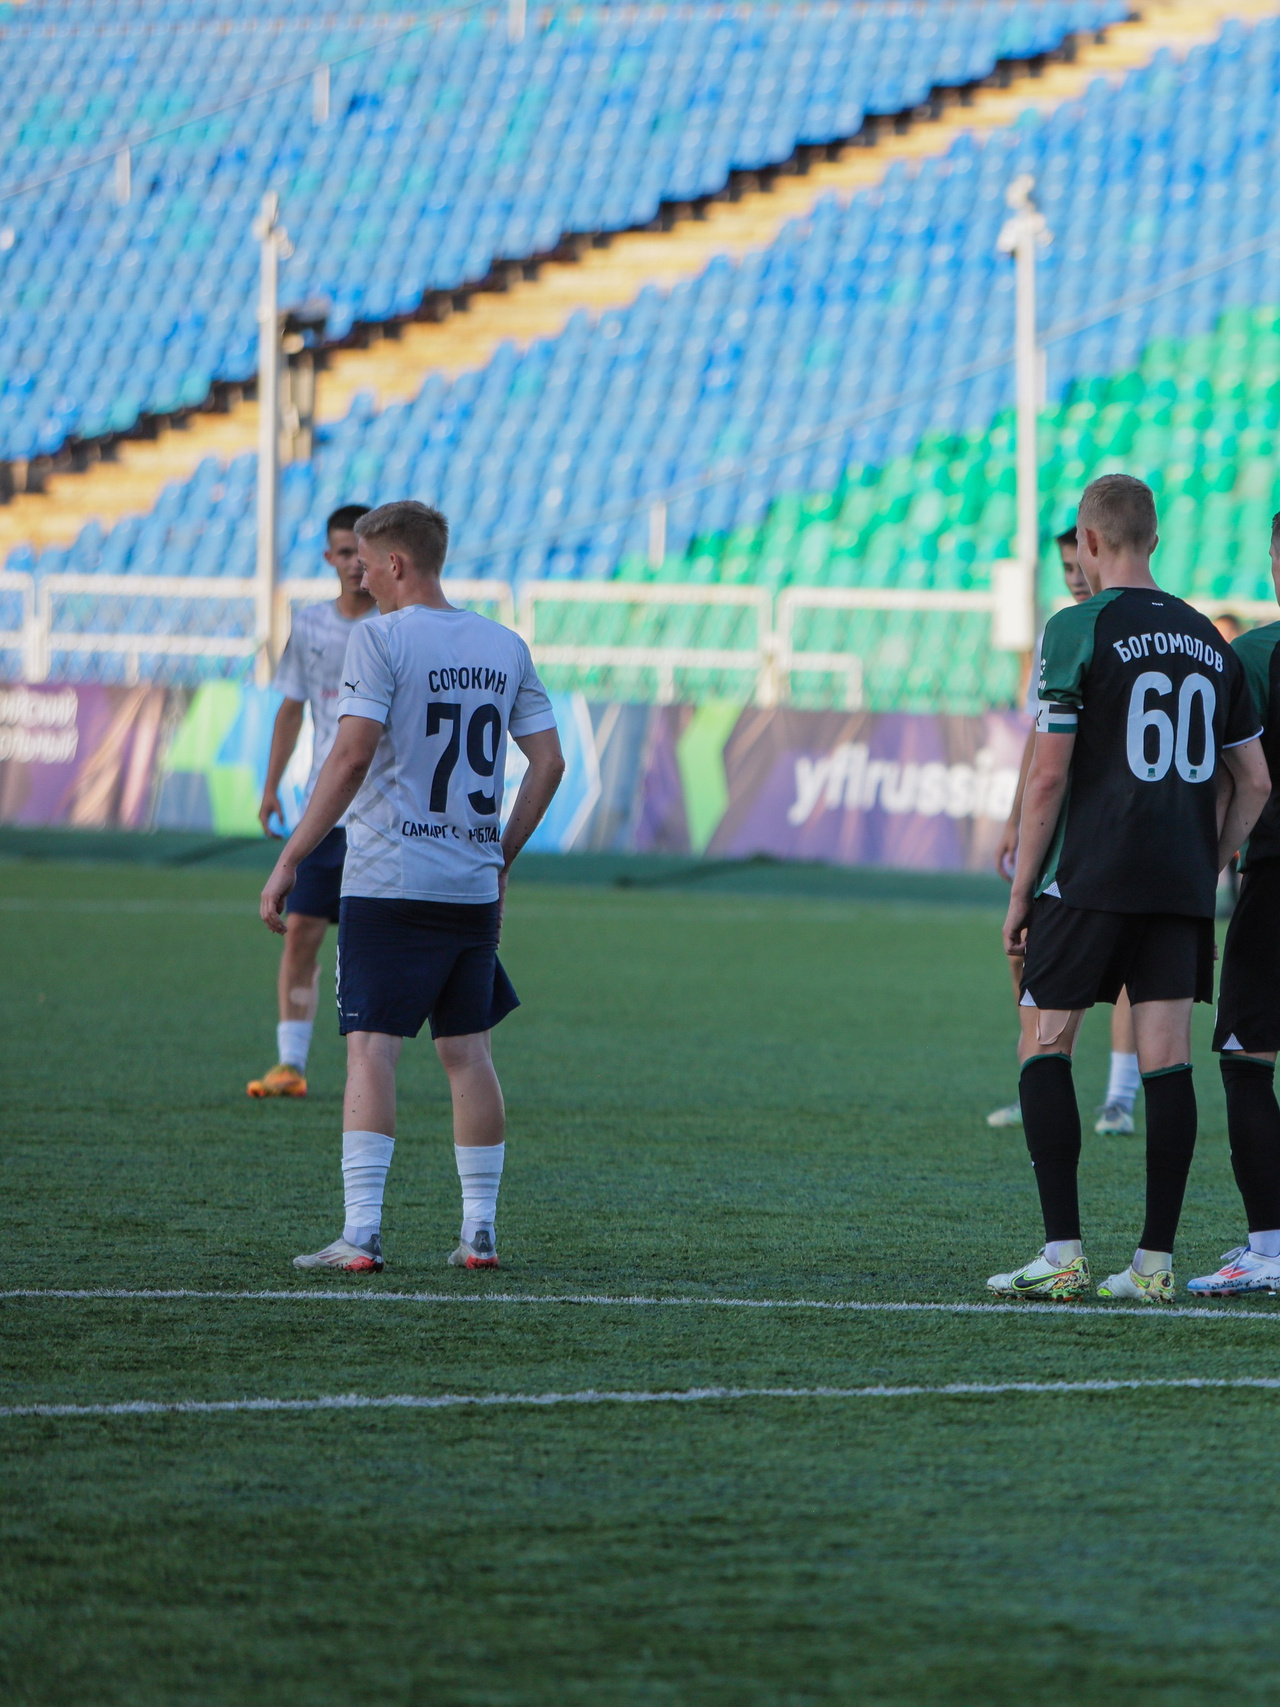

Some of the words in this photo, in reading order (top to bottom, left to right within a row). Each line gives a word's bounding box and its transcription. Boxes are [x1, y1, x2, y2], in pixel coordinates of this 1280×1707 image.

[428, 667, 508, 695] СОРОКИН
[1113, 632, 1224, 673] БОГОМОЛОВ
[426, 702, 502, 816] 79
[1126, 671, 1217, 784] 60
